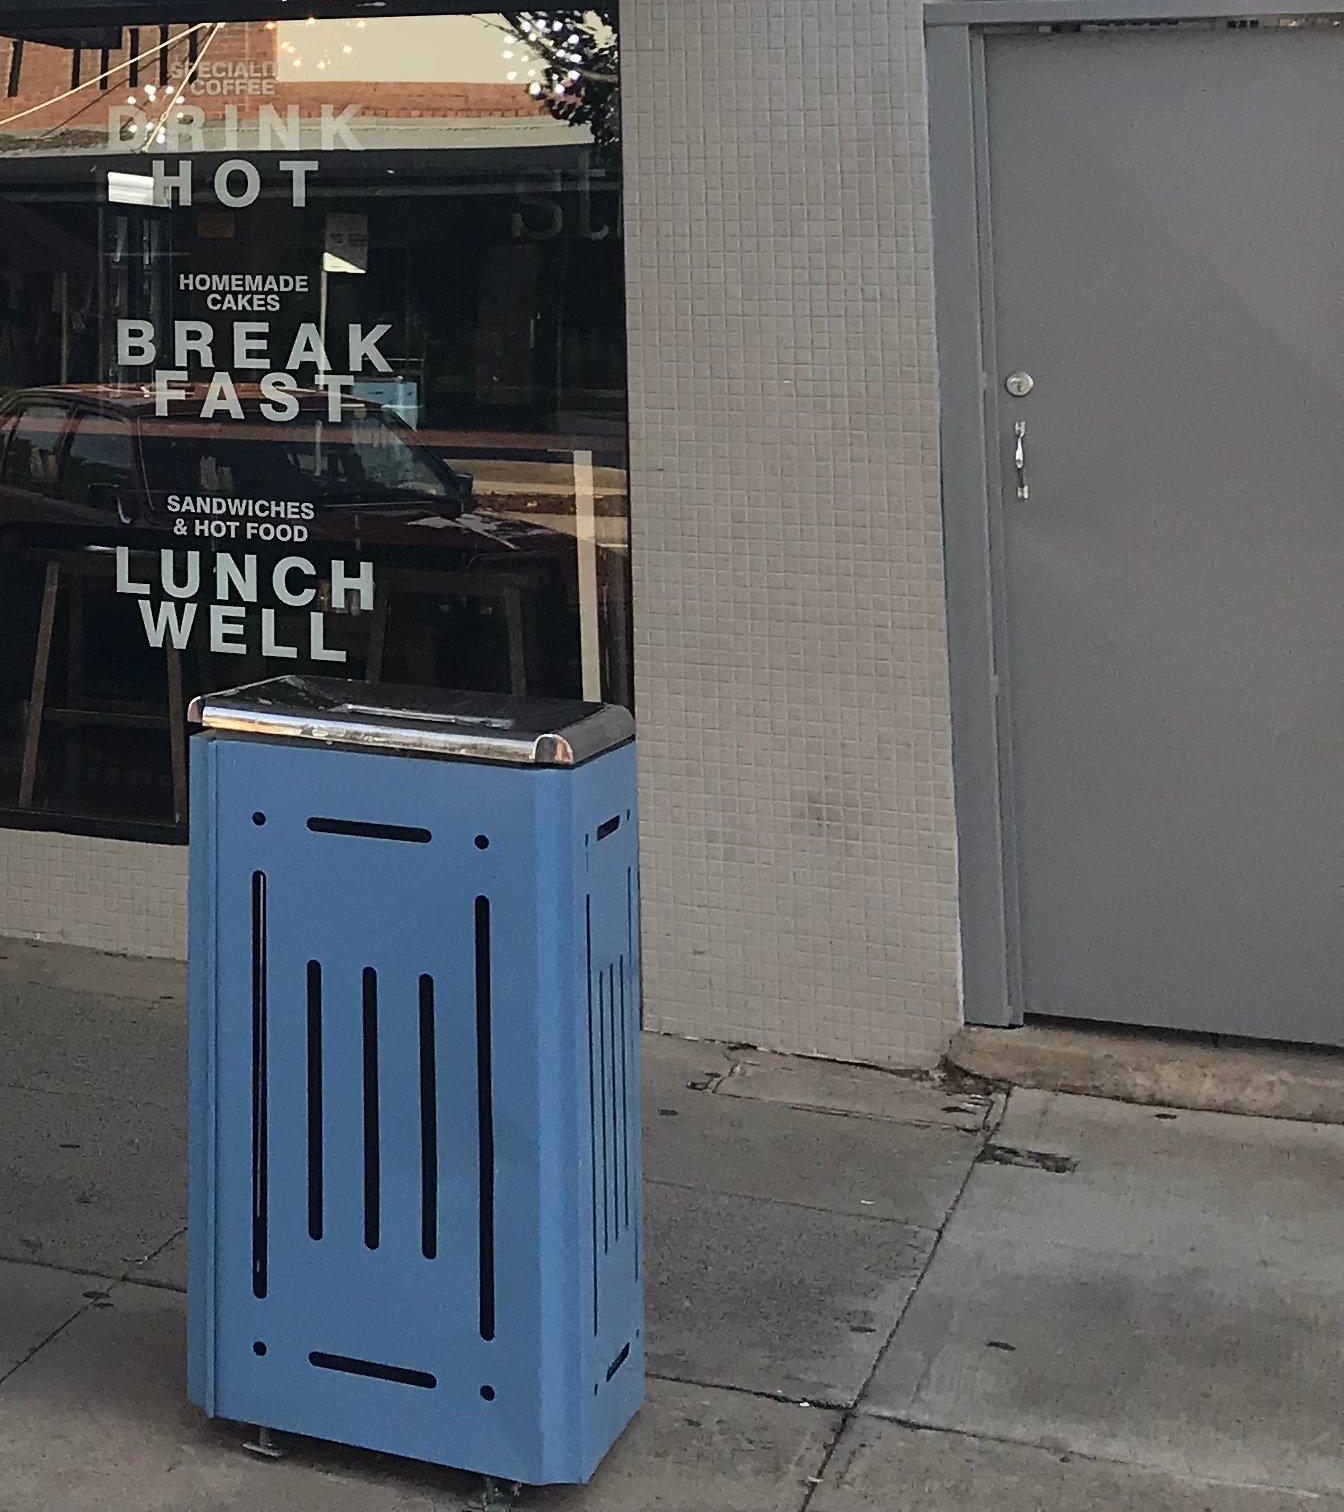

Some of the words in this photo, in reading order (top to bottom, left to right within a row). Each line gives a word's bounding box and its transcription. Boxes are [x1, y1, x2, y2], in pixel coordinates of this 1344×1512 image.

[190, 78, 276, 96] COFFEE
[108, 103, 366, 153] DRINK
[152, 159, 319, 208] HOT
[179, 273, 309, 292] HOMEMADE
[206, 293, 280, 311] CAKES
[117, 319, 394, 373] BREAK
[154, 369, 355, 423] FAST
[166, 495, 315, 520] SANDWICHES
[173, 518, 188, 536] &
[194, 520, 240, 539] HOT
[246, 523, 308, 542] FOOD
[116, 545, 374, 611] LUNCH
[137, 599, 347, 663] WELL
